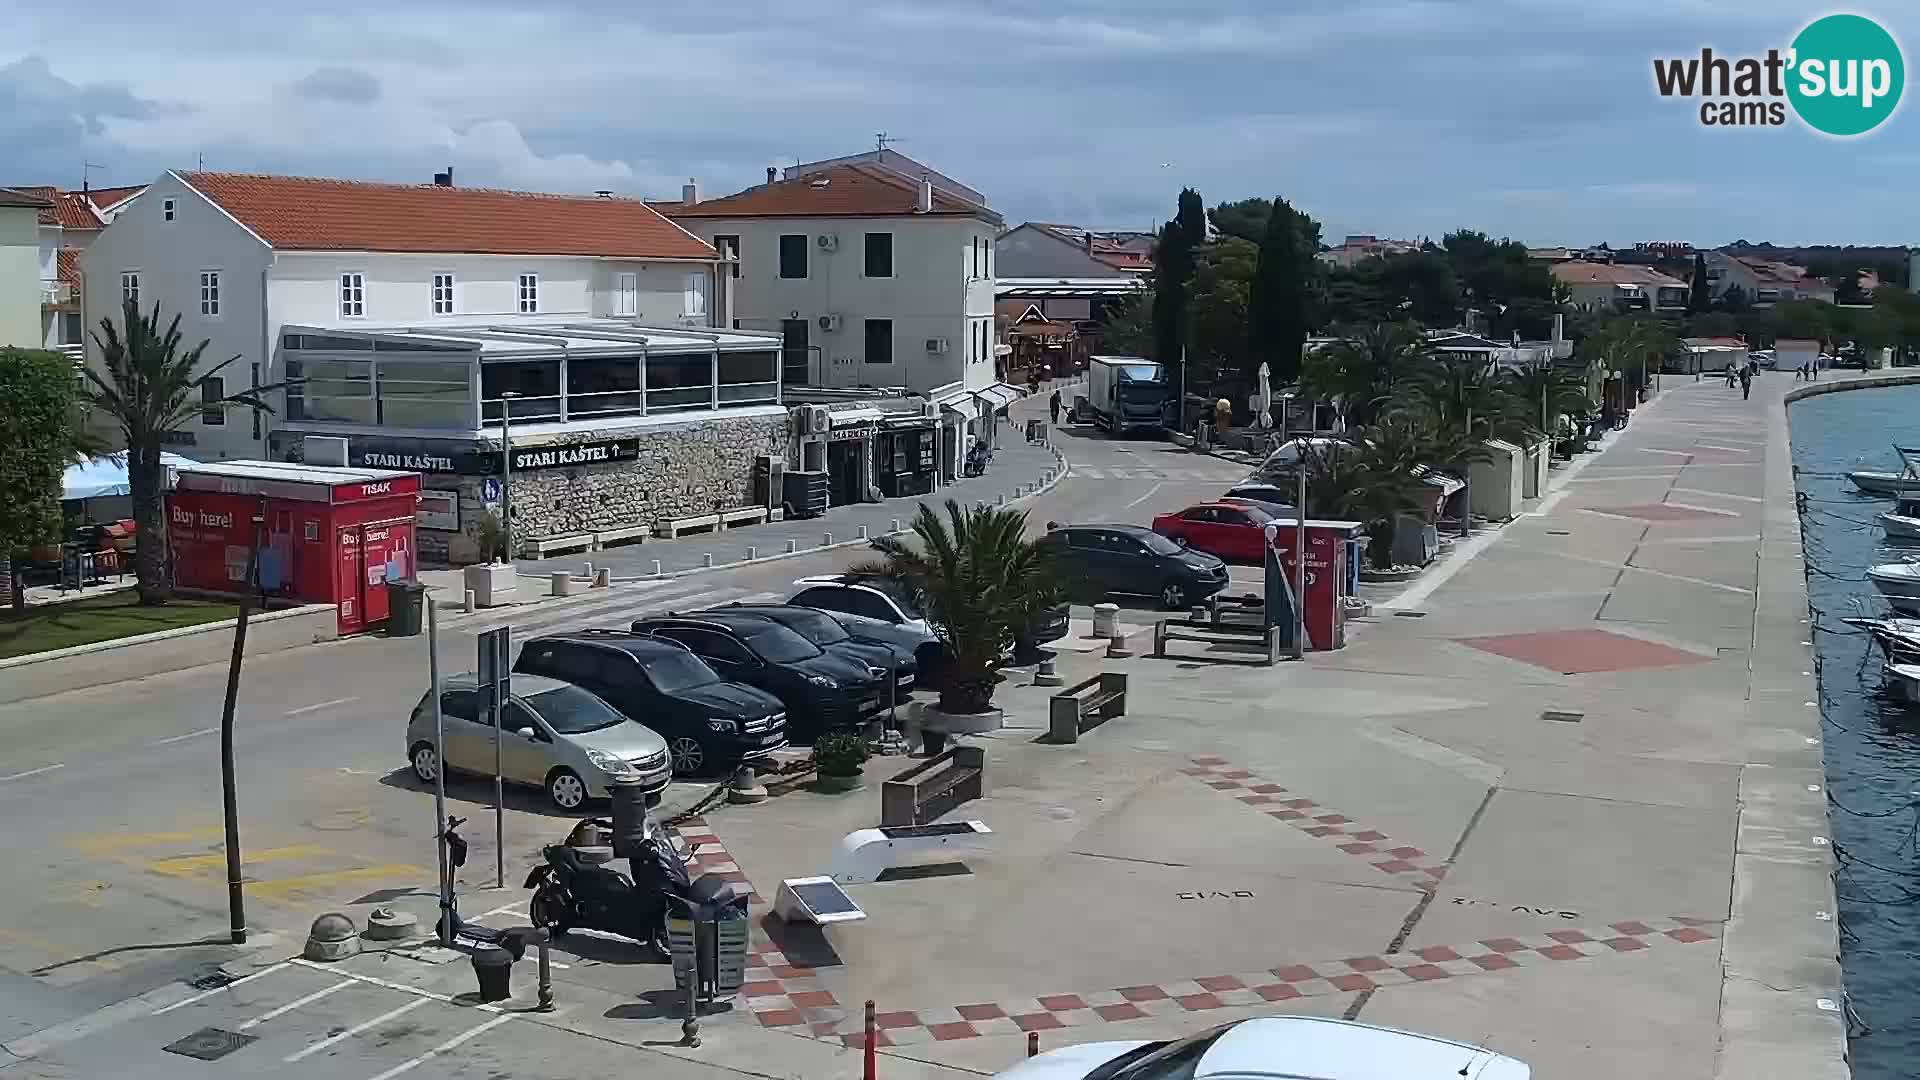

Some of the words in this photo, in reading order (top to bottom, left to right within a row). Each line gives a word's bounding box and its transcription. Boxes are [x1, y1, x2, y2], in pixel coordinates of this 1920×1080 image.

[364, 453, 401, 467] STARI
[404, 454, 455, 470] KAŠTEL
[516, 451, 556, 468] STARI
[559, 445, 609, 464] KAŠTEL
[361, 482, 391, 495] TISAK
[173, 506, 194, 528] Buy
[200, 509, 233, 529] here!
